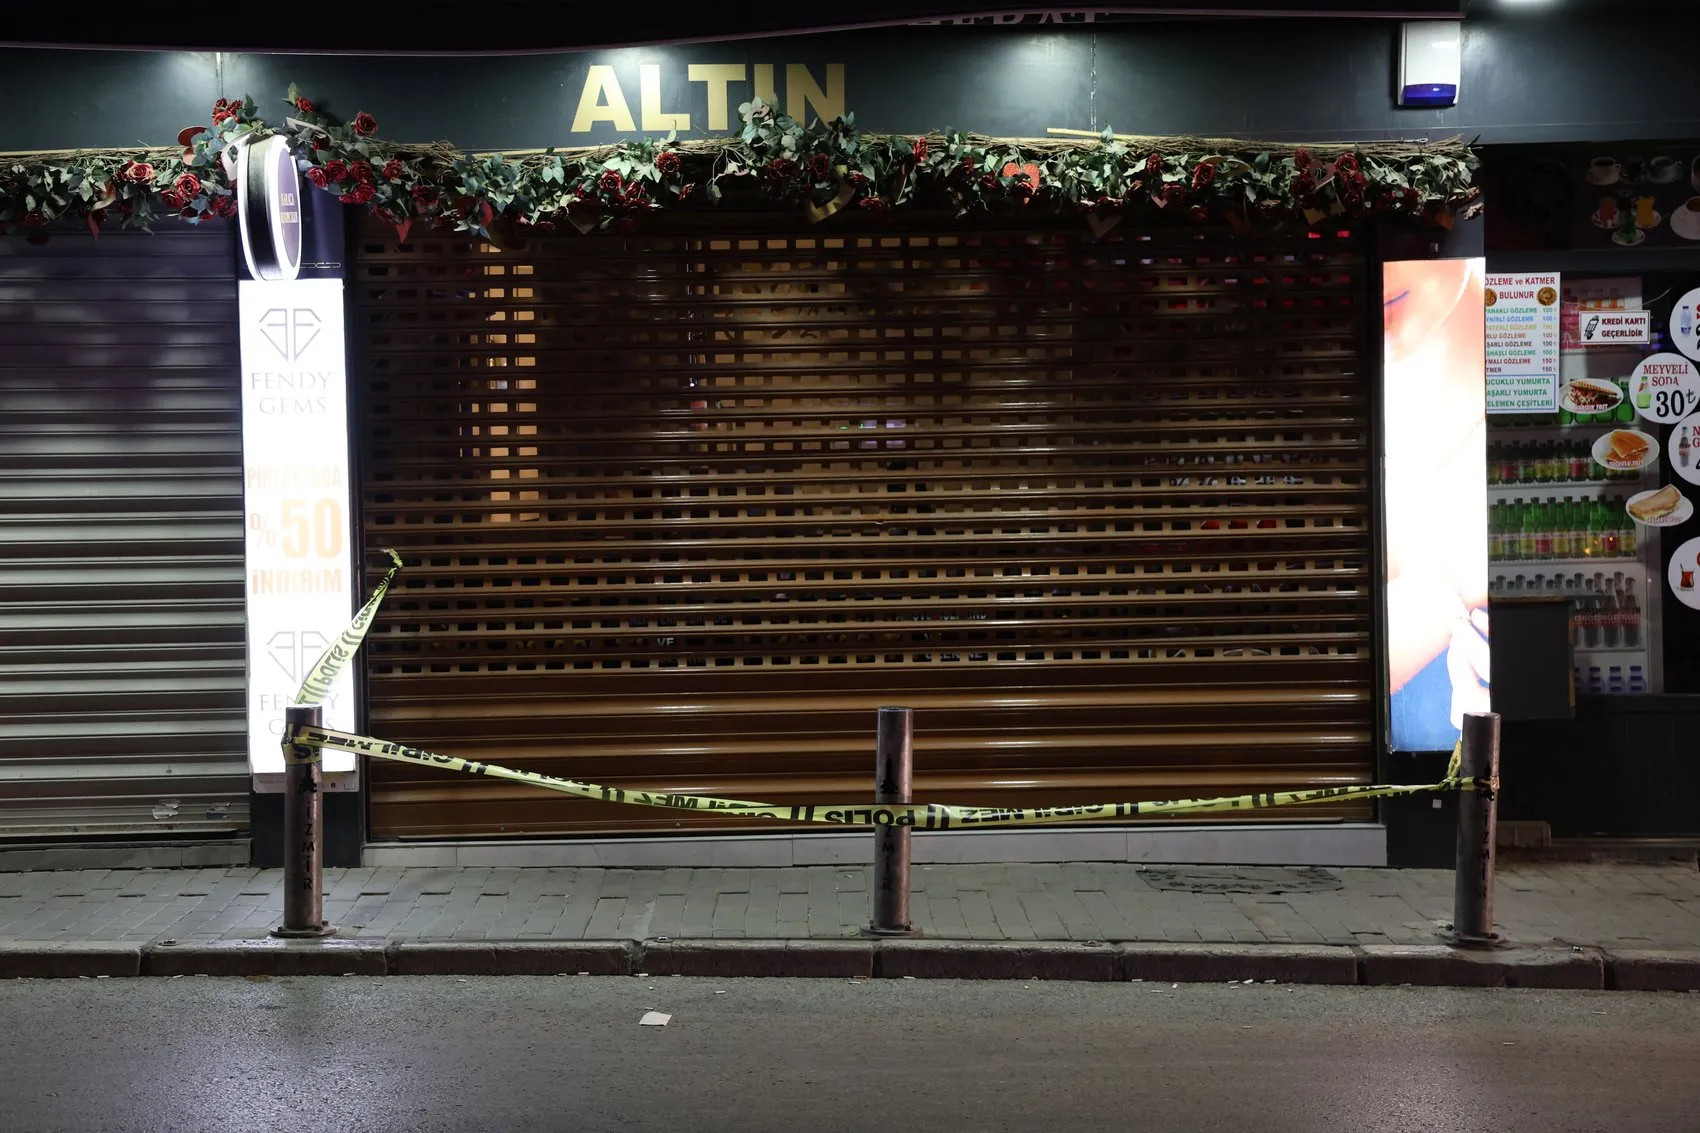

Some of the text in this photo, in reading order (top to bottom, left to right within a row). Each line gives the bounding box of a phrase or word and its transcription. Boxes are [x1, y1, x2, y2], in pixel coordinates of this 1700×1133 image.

[570, 63, 845, 131] ALTIN
[1525, 276, 1555, 285] KATMER
[1499, 291, 1534, 299] BULUNUR
[1601, 316, 1646, 325] KREDİ KARTI
[1601, 328, 1643, 338] GEÇERLİDİR
[1643, 362, 1688, 374] MEYVELİ
[250, 370, 332, 390] FENDY
[1651, 376, 1679, 386] SODA
[259, 396, 327, 415] GEMS
[1517, 399, 1553, 407] ÇEŞİTLERİ
[258, 692, 340, 712] FENY
[268, 717, 336, 736] GS
